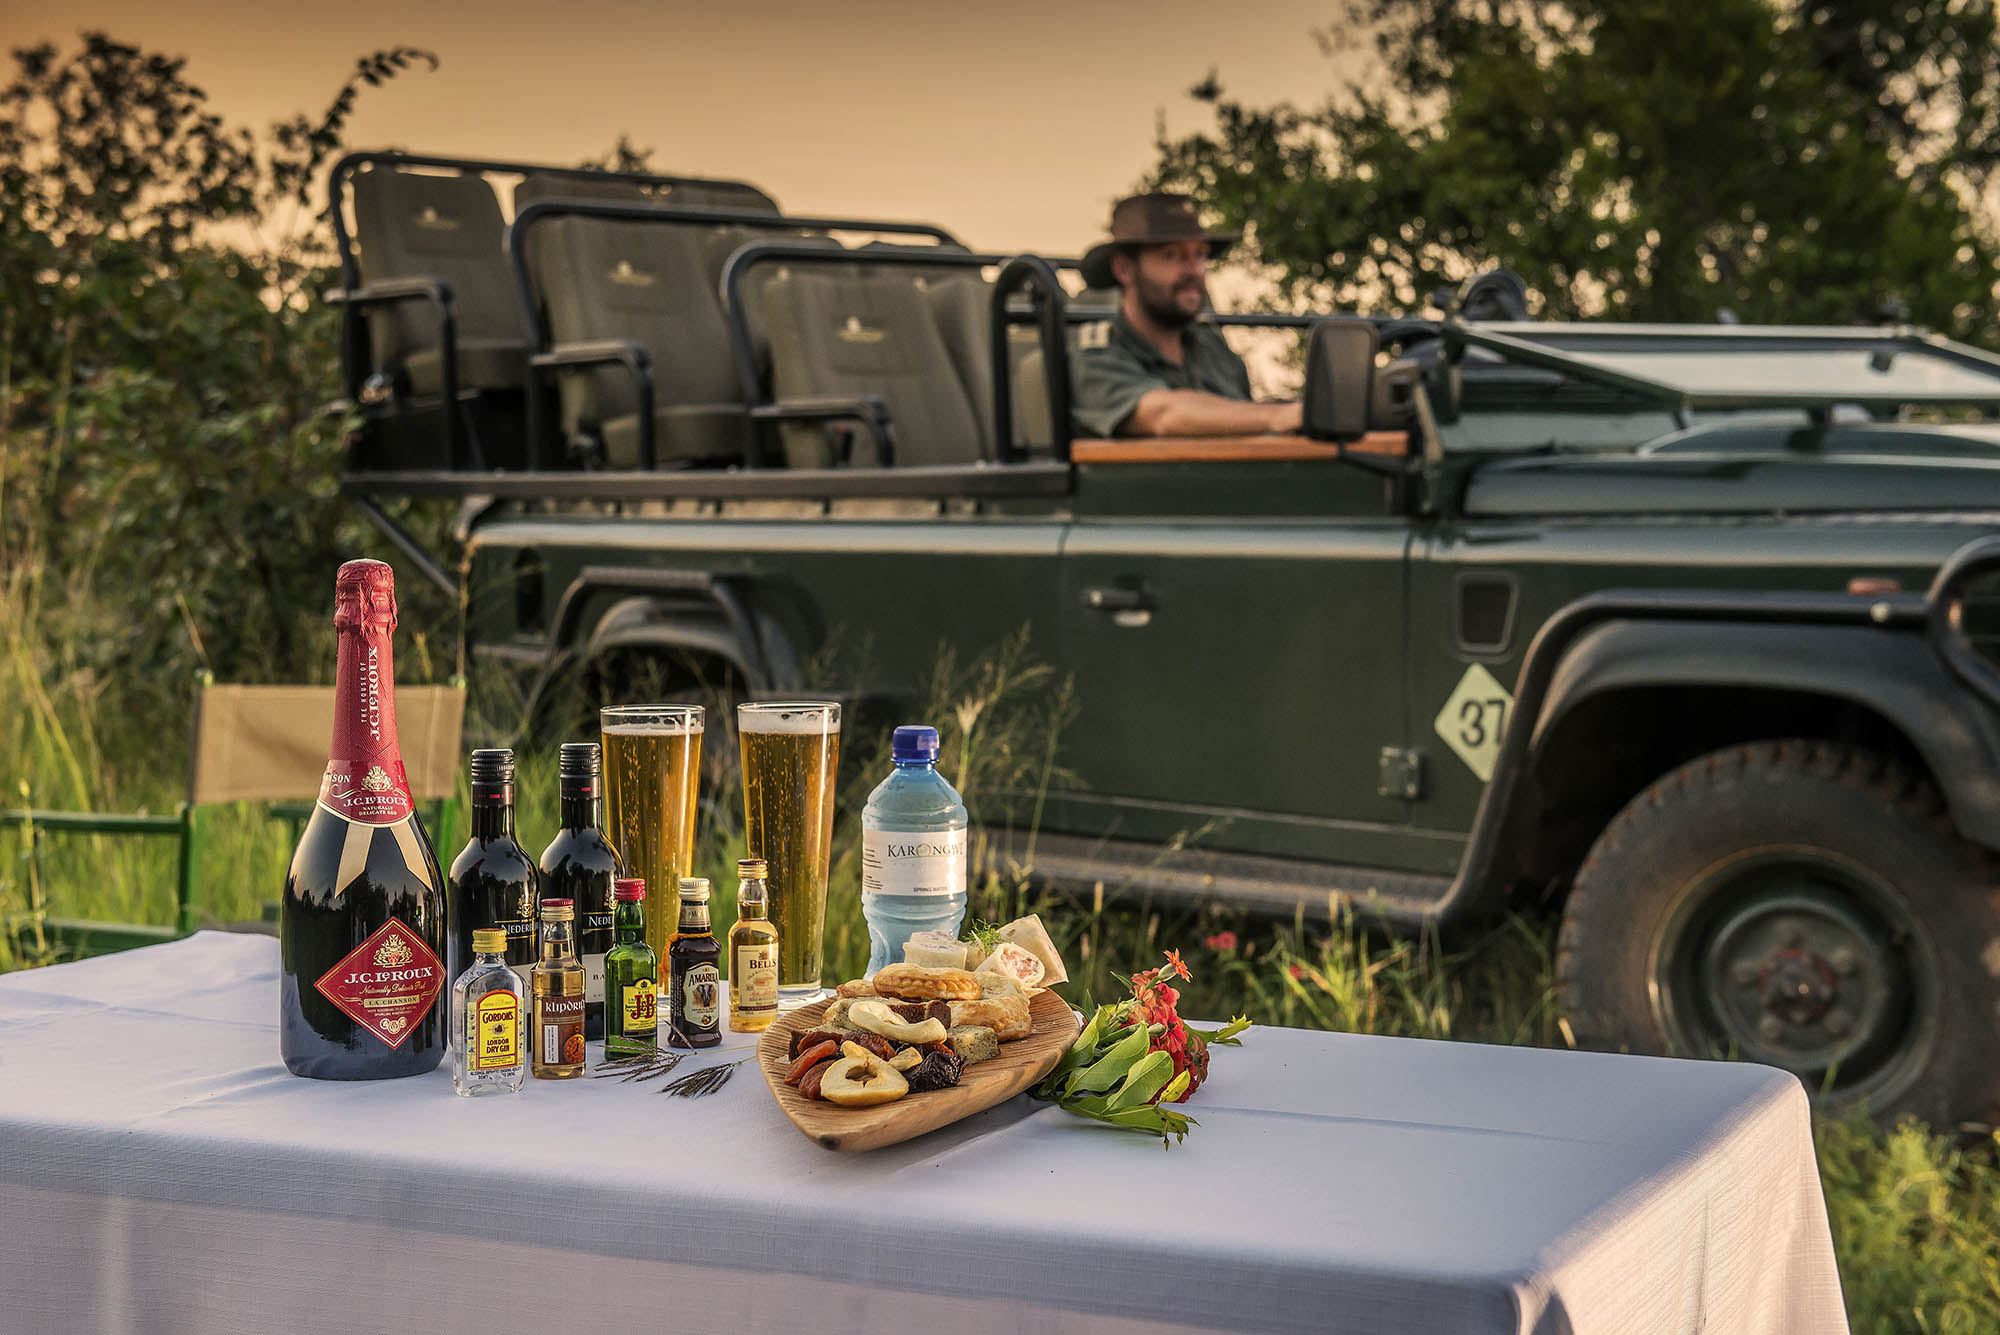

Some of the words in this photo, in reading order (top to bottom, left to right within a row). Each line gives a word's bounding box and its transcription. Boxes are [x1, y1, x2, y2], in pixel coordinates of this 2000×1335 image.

[359, 662, 367, 672] OF
[359, 677, 367, 703] HOUSE
[360, 708, 368, 723] THE
[1461, 699, 1505, 748] 37
[382, 996, 417, 1004] CHANSON
[487, 1038, 509, 1046] LONDON
[486, 1045, 499, 1054] DRY
[499, 1044, 510, 1052] GIN
